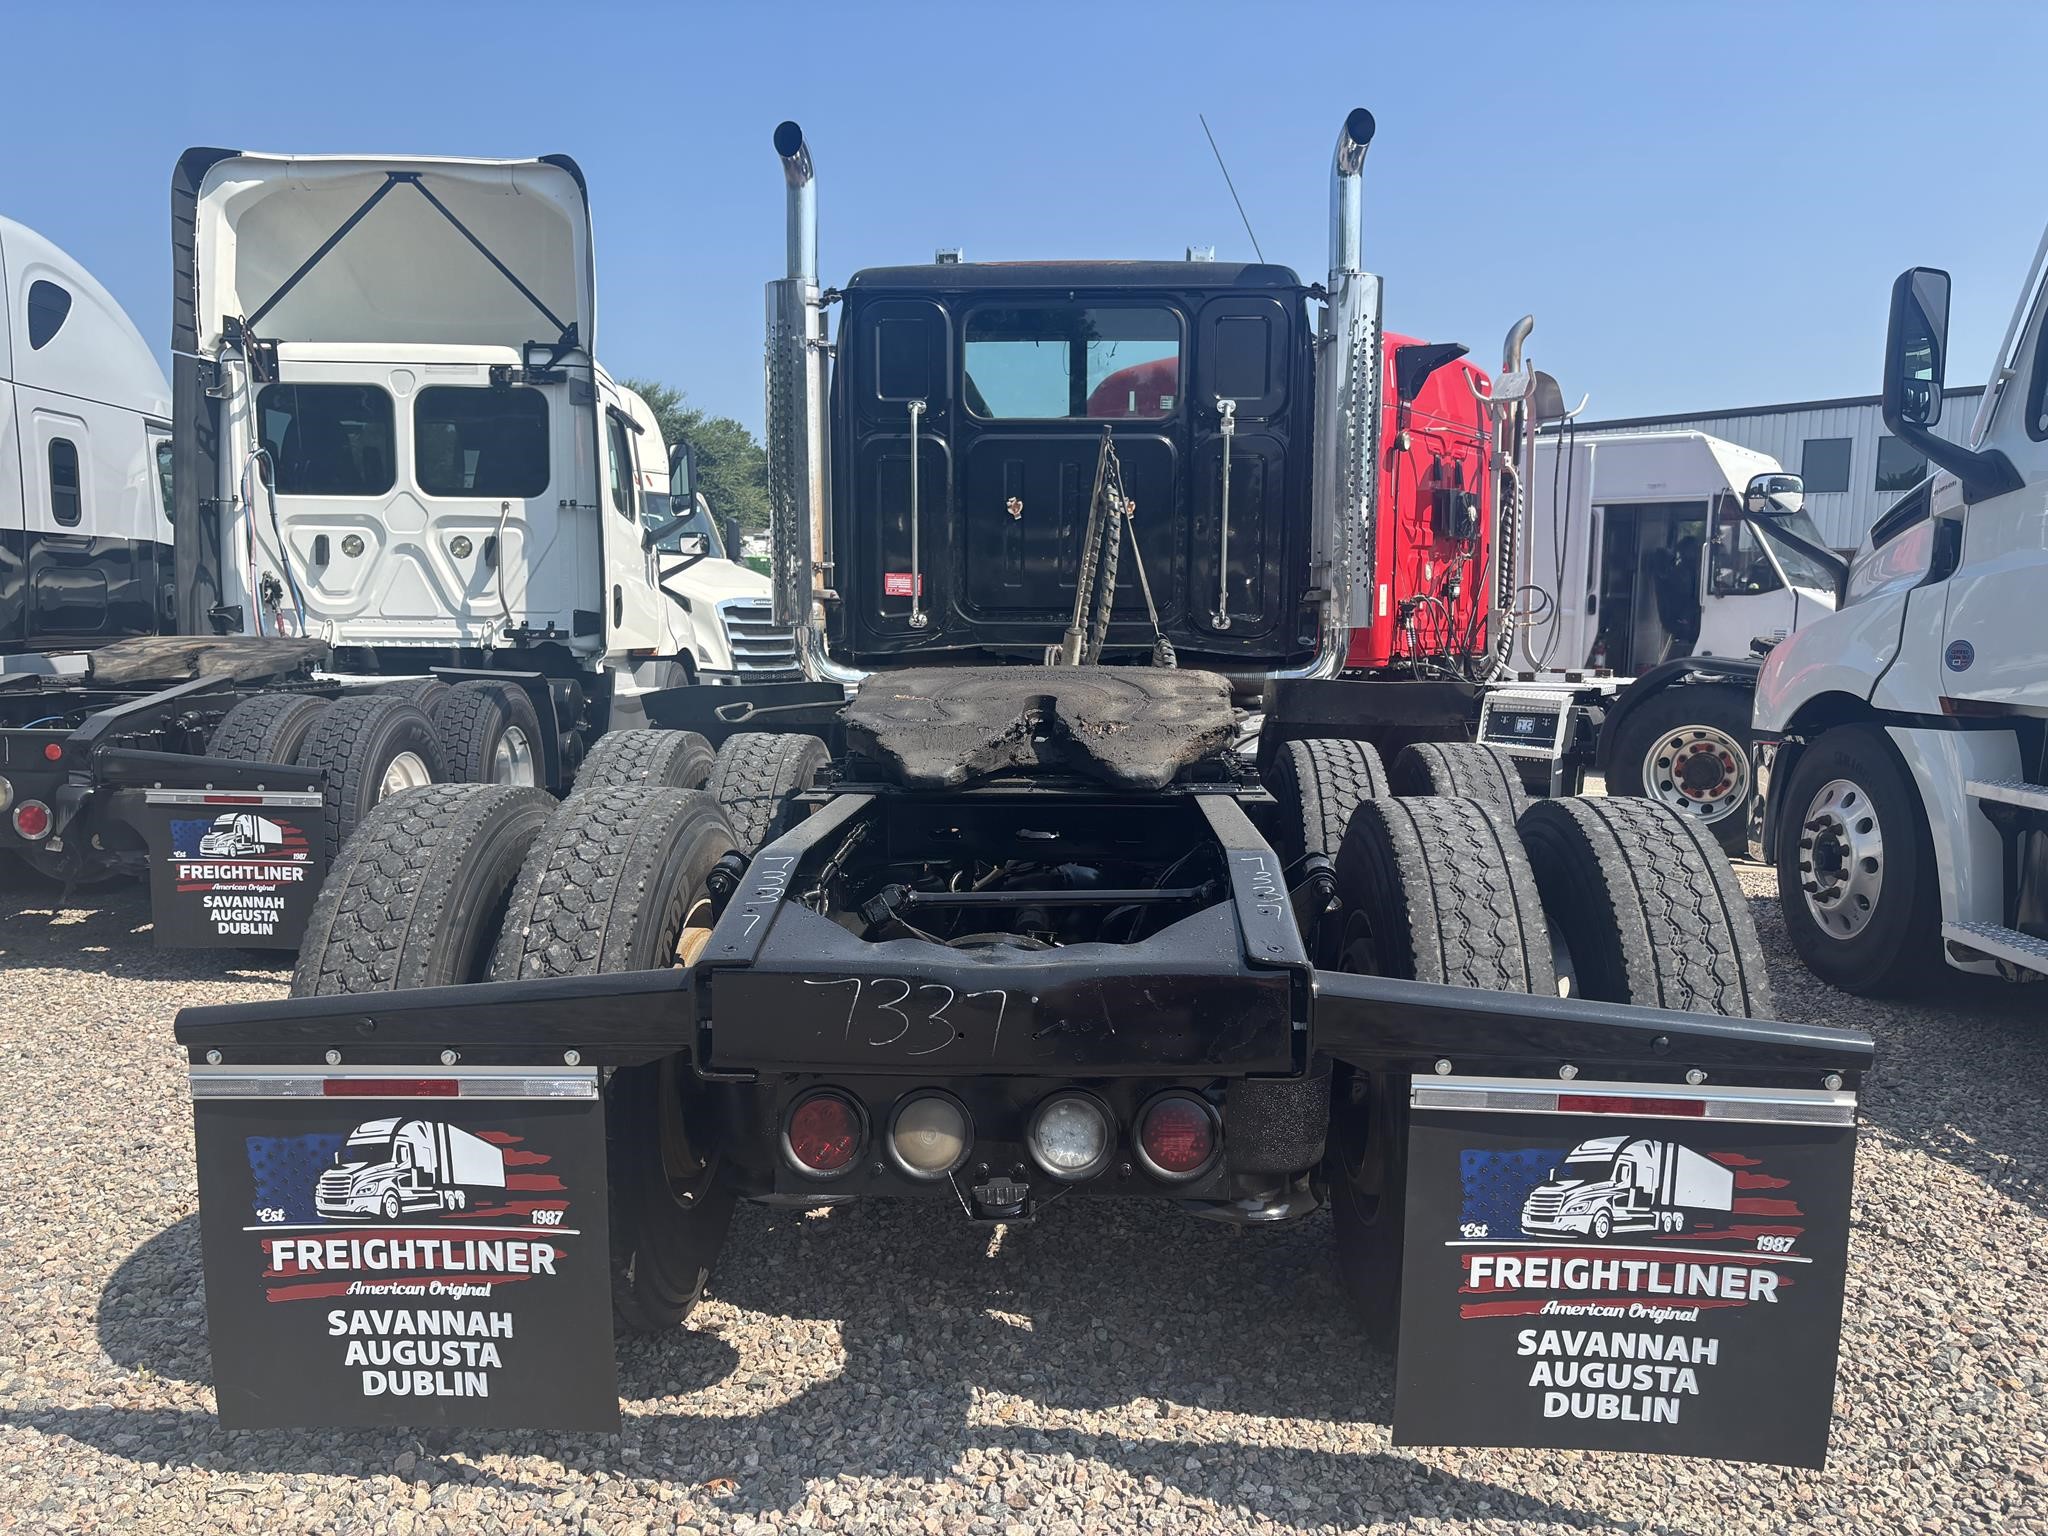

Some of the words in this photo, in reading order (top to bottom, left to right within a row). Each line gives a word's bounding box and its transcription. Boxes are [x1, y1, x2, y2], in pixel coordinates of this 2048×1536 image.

[179, 864, 304, 881] FREIGHTLINER
[211, 883, 247, 891] American
[248, 884, 276, 893] Original
[203, 895, 285, 909] SAVANNAH
[210, 909, 279, 922] AUGUSTA
[218, 922, 273, 935] DUBLIN
[803, 978, 1006, 1056] 7337
[256, 1207, 286, 1223] Est
[530, 1210, 564, 1226] 1987
[1459, 1222, 1489, 1237] Est
[1755, 1235, 1796, 1252] 1987
[271, 1239, 557, 1275] FREIGHTLINER
[345, 1280, 425, 1297] American
[429, 1281, 491, 1300] Original
[1469, 1257, 1779, 1304] FREIGHTLINER
[1539, 1300, 1624, 1318] American
[1628, 1302, 1699, 1324] Original
[327, 1309, 514, 1338] SAVANNAH
[344, 1340, 503, 1368] AUGUSTA
[1516, 1329, 1719, 1365] SAVANNAH
[363, 1370, 489, 1398] DUBLIN
[1528, 1361, 1700, 1395] AUGUSTA
[1543, 1391, 1680, 1424] DUBLIN
